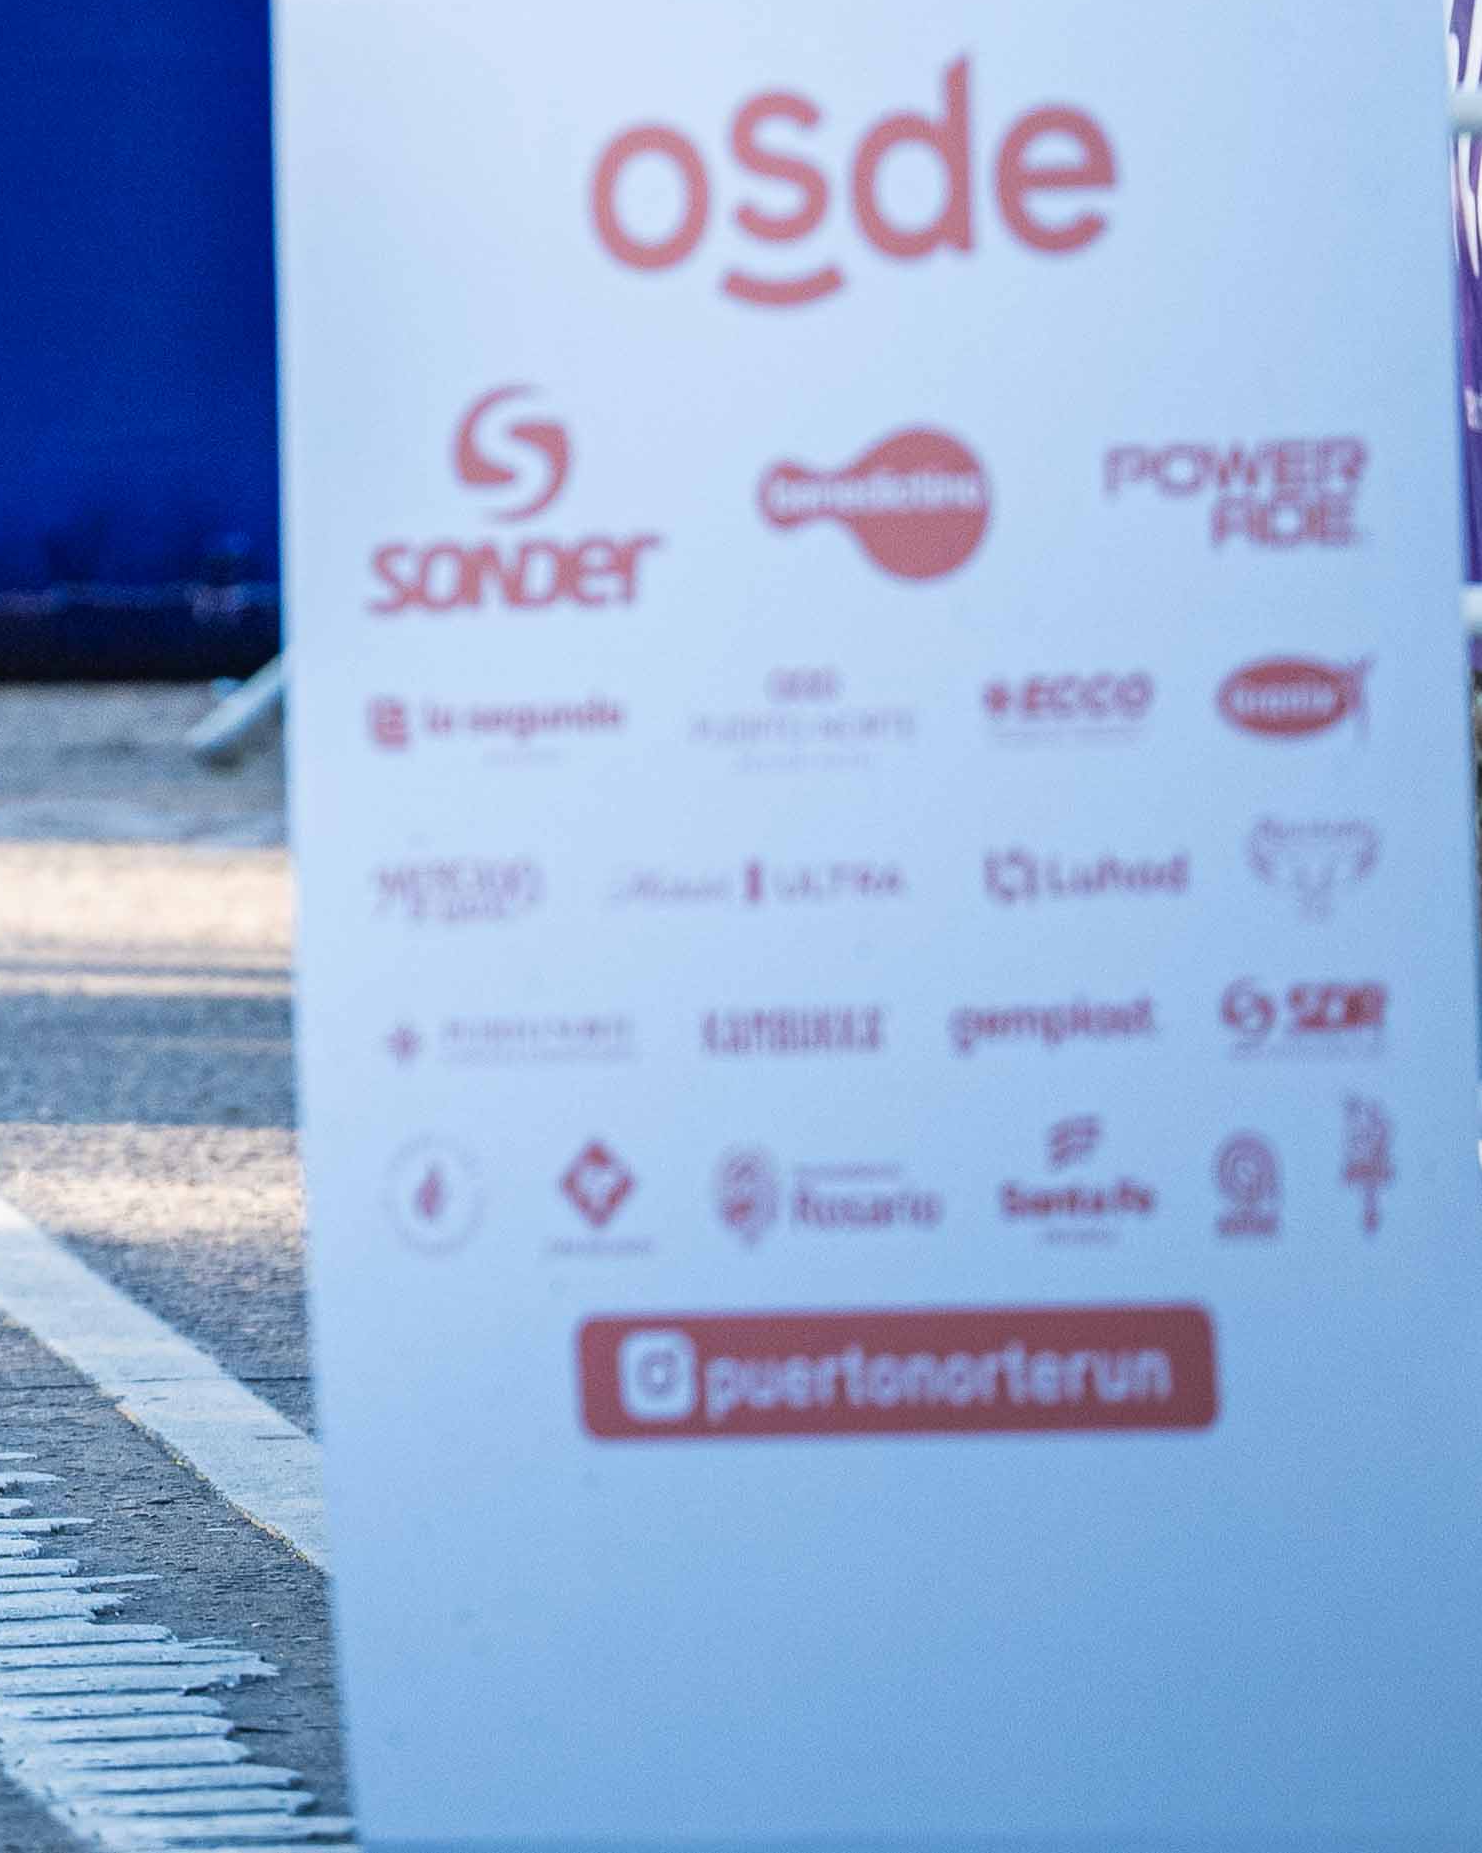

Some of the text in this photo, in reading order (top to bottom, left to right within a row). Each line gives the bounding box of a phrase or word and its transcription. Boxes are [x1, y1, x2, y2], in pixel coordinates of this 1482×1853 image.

[591, 48, 1117, 272] osde
[1022, 672, 1154, 721] ECCO
[705, 1343, 1172, 1423] puertonorterun
